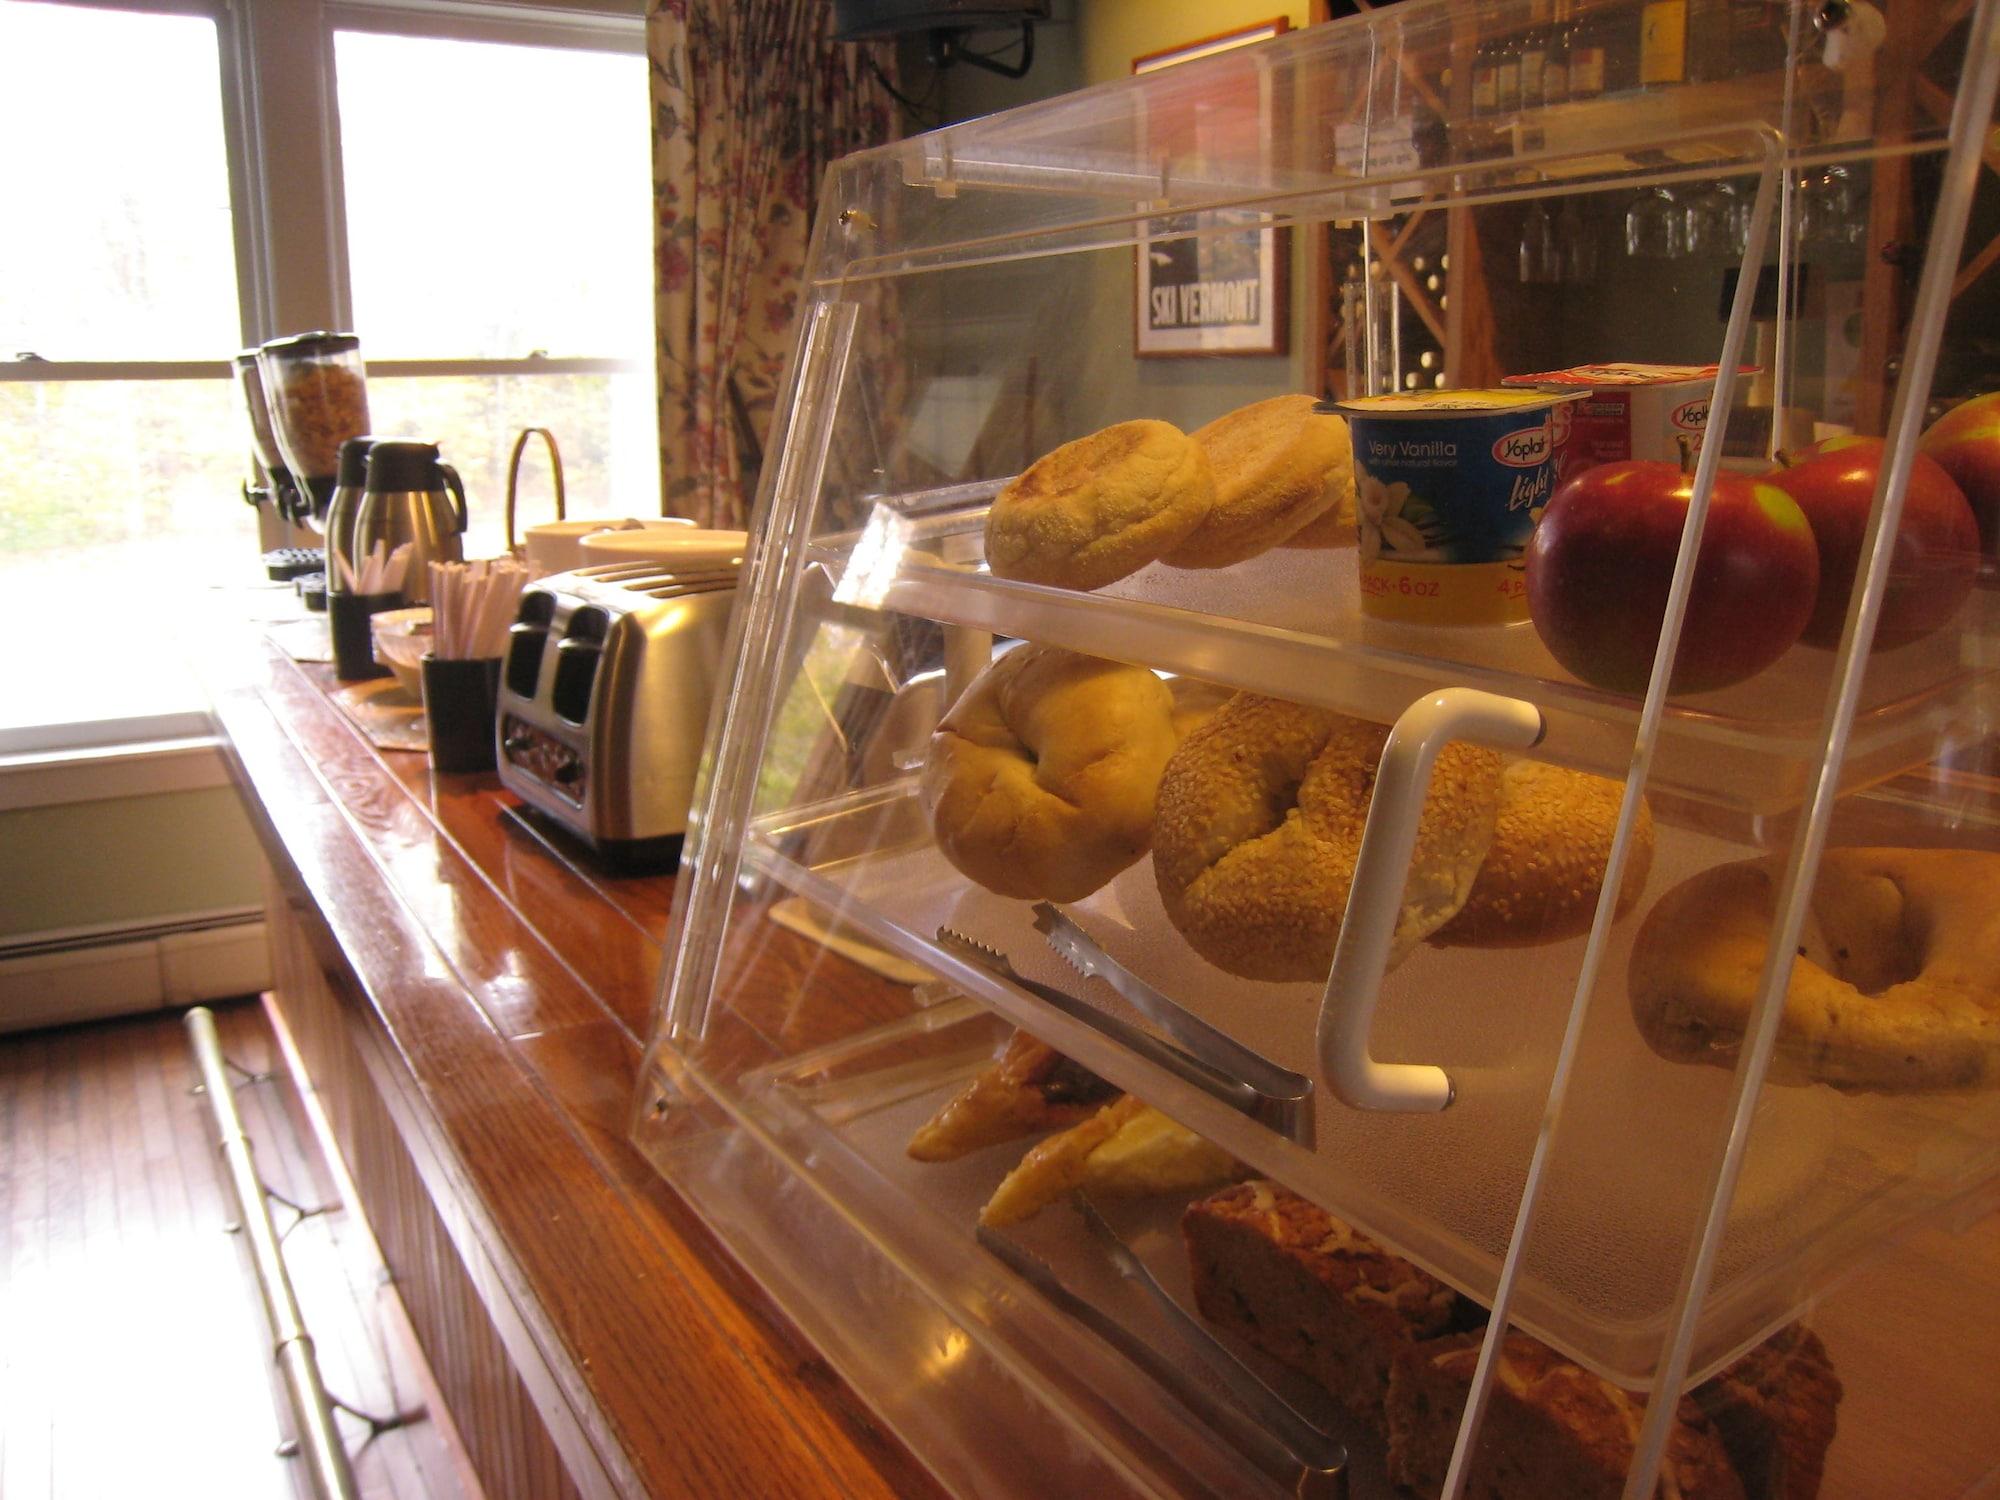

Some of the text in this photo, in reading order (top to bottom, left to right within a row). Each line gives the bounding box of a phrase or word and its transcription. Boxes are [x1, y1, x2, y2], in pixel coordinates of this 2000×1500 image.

[1152, 278, 1259, 326] SKI VERMONT
[1368, 439, 1457, 458] Very Vanilla
[1506, 465, 1550, 511] Light
